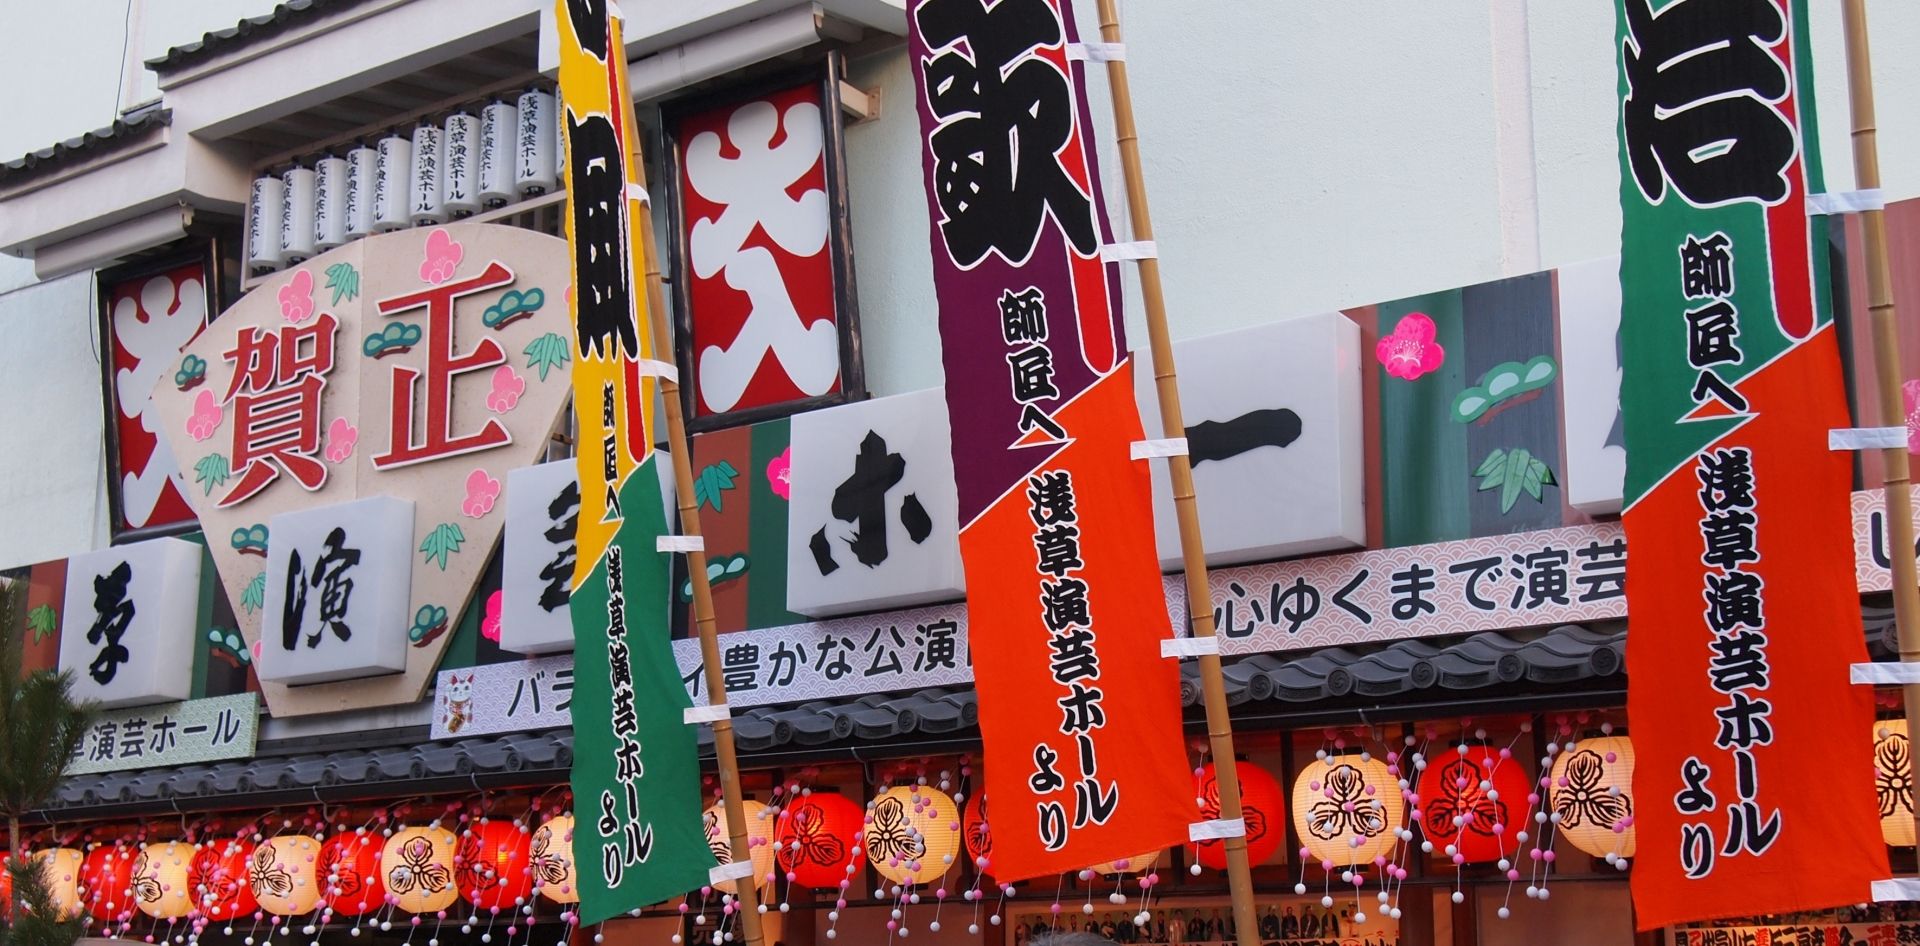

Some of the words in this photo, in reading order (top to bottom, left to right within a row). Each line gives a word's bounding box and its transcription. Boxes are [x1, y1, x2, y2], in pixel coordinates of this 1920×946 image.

[416, 129, 439, 212] 浅草演芸ホール
[449, 116, 468, 200] 浅草演芸ホール
[520, 95, 538, 178] 浅草演芸ホール
[1000, 287, 1066, 442] 師匠へ
[1680, 232, 1750, 413] 師匠へ
[602, 382, 622, 518] 師匠へ
[282, 527, 361, 650] 演
[810, 429, 933, 575] ホ
[1214, 538, 1626, 637] 心ゆくまで演芸
[607, 548, 652, 865] 浅草演芸ホール
[1028, 473, 1118, 828] 浅草演芸ホール
[1698, 448, 1782, 860] 浅草演芸ホール
[597, 790, 625, 890] より
[1031, 745, 1068, 852] より
[1675, 757, 1715, 880] より
